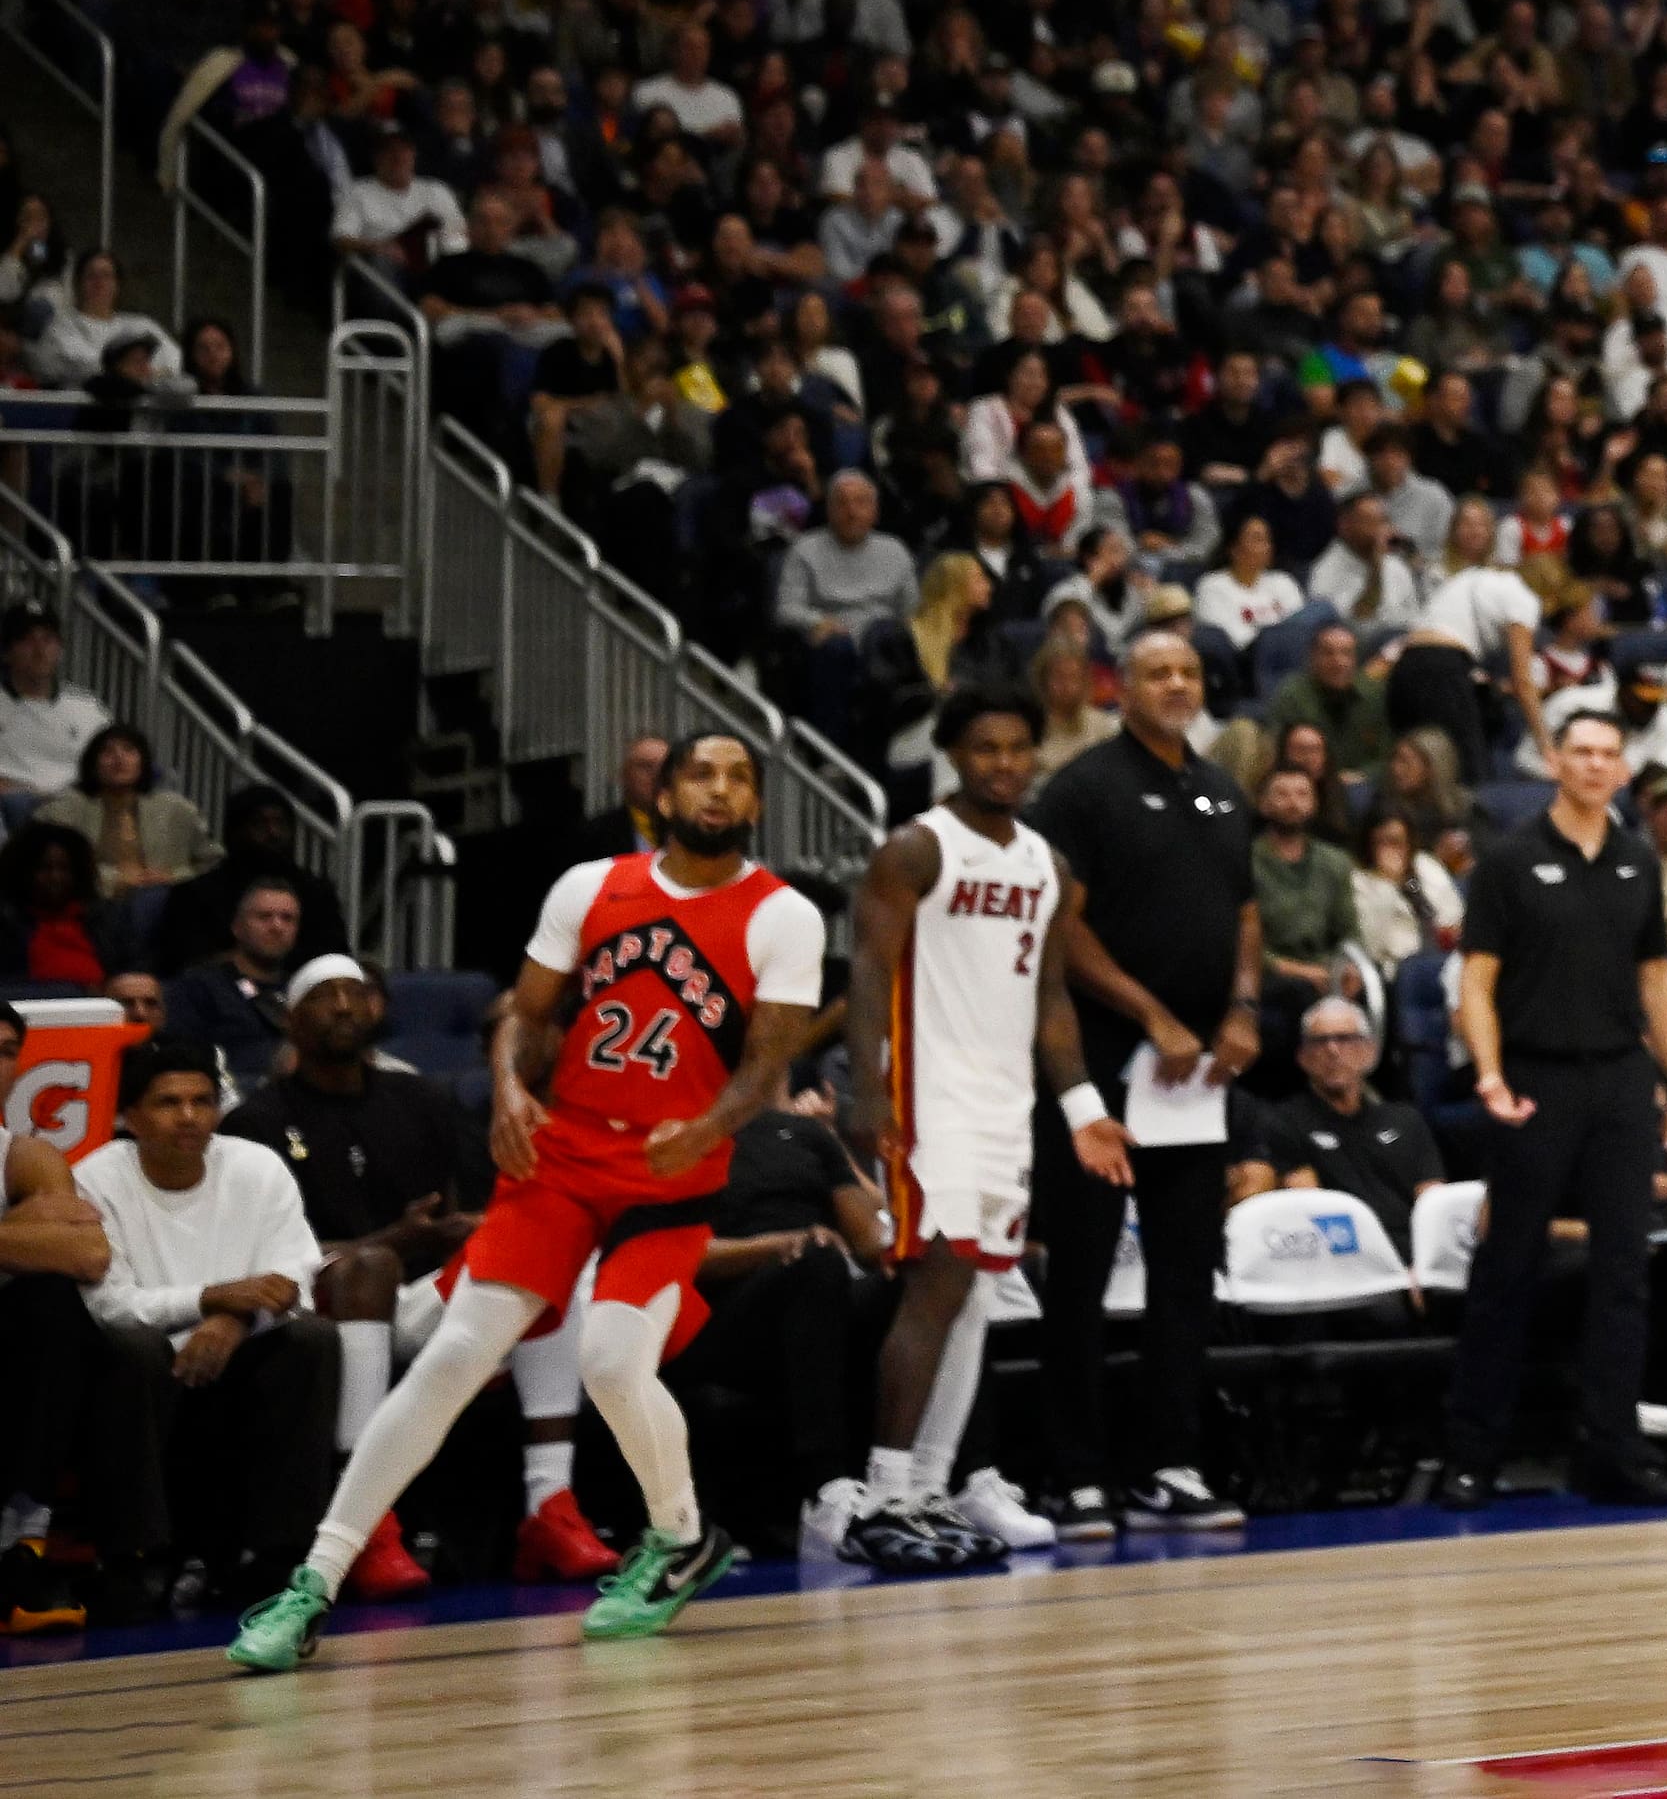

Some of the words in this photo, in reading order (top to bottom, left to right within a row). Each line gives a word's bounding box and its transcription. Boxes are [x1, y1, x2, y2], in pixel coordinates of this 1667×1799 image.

[946, 878, 1048, 923] HEAT
[1014, 932, 1034, 976] 2
[585, 1000, 682, 1081] 24
[4, 1059, 91, 1153] G
